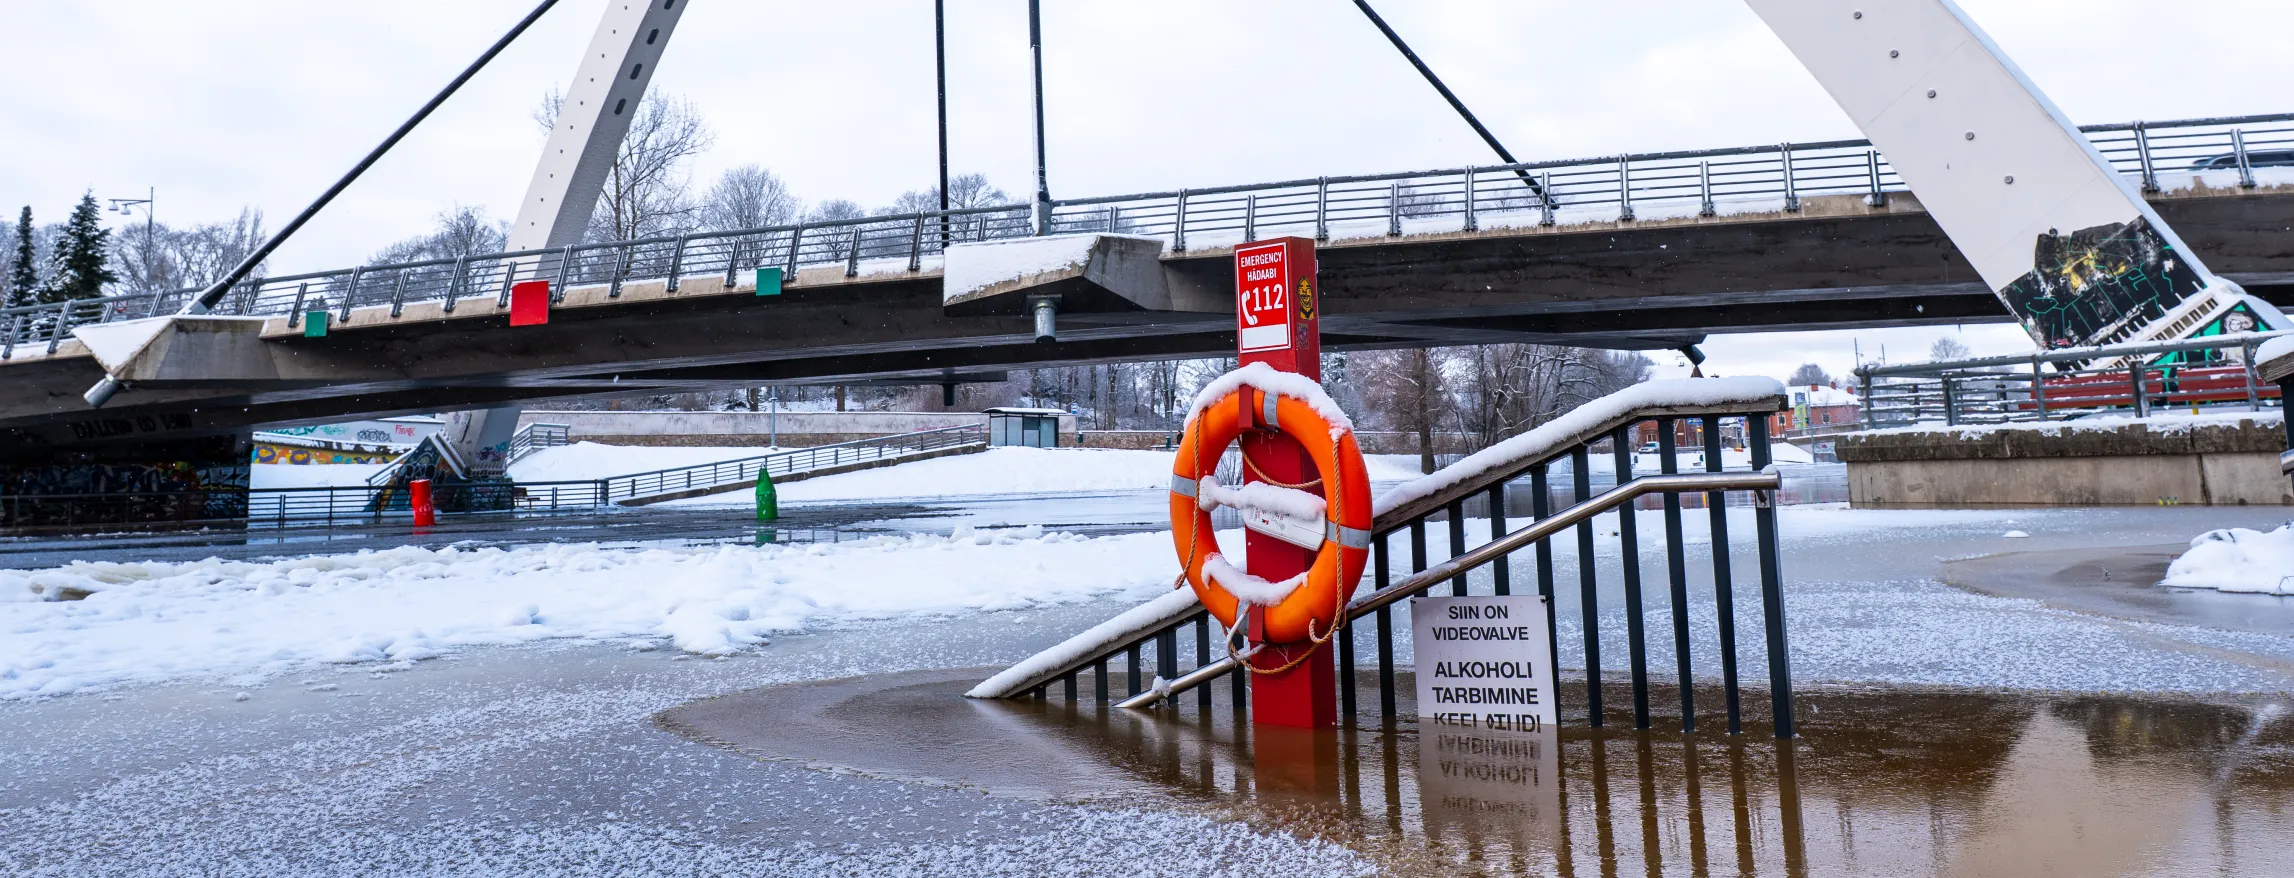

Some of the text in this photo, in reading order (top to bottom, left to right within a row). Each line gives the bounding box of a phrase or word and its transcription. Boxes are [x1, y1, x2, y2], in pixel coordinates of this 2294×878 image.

[1240, 251, 1283, 268] EMERGENCY
[1247, 268, 1277, 282] HÄDAABI
[1252, 283, 1284, 312] 112
[1448, 605, 1508, 620] SIIN ON
[1432, 626, 1529, 641] VIDEOVALVE
[1434, 661, 1533, 679] ALKOHOLI
[1432, 687, 1539, 705] TARBIMINE
